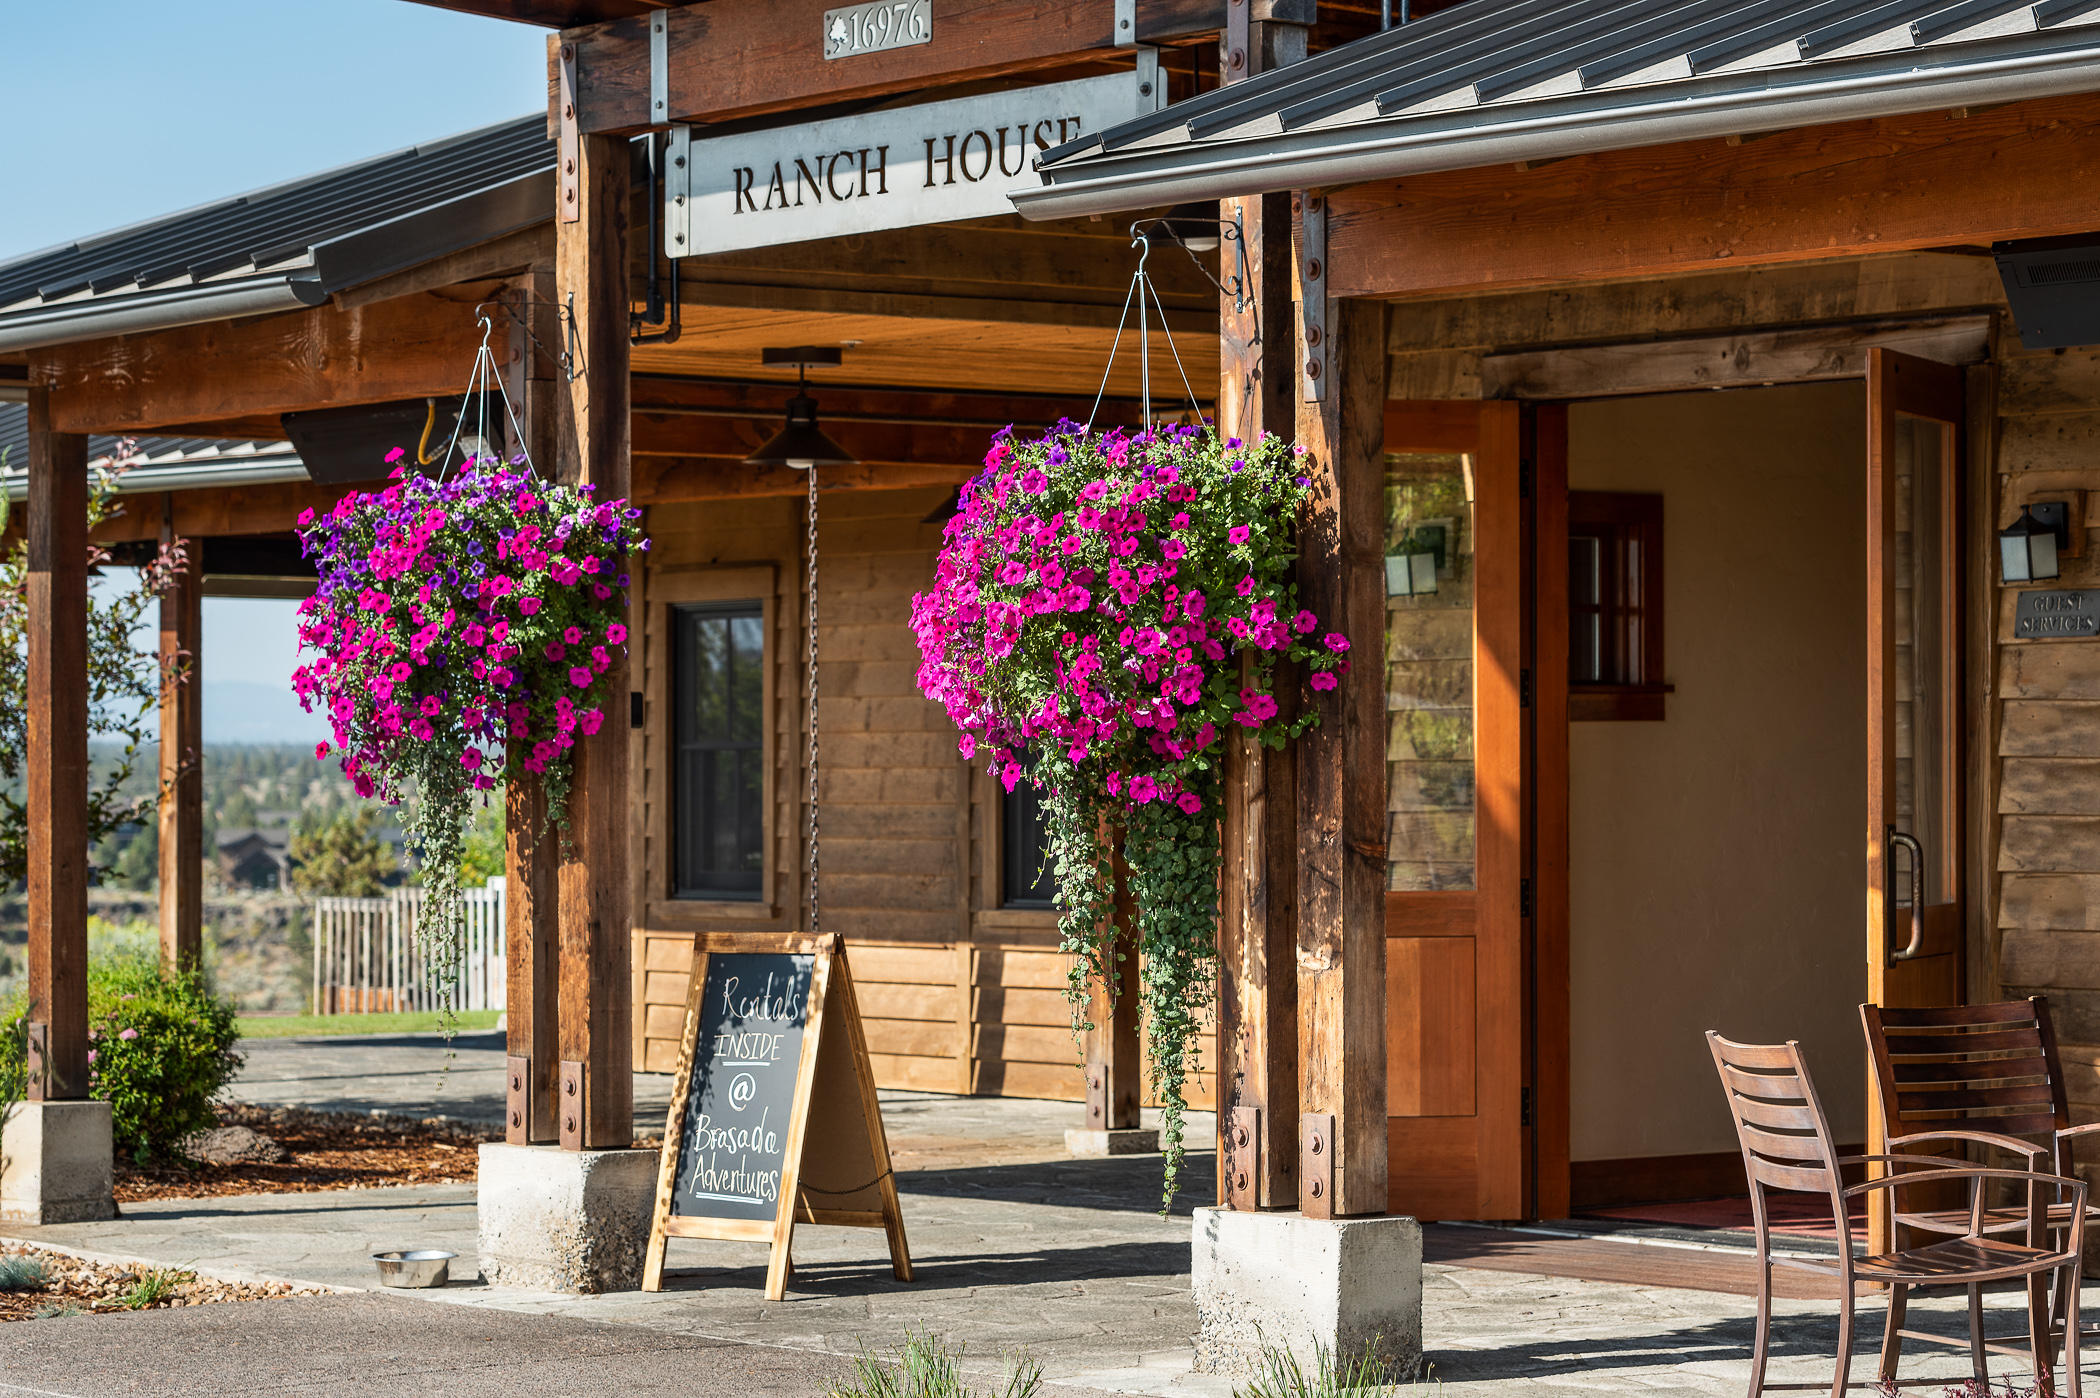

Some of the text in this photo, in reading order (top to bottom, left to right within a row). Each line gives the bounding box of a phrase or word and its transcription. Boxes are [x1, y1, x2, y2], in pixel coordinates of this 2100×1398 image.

[850, 0, 924, 50] 16976
[732, 145, 889, 215] RANCH
[2021, 616, 2093, 632] SERVICES
[2033, 595, 2085, 611] GUEST
[722, 972, 800, 1021] Rentals
[714, 1032, 785, 1061] INSIDE
[728, 1072, 756, 1111] @
[694, 1106, 780, 1154] Brasada
[689, 1152, 779, 1202] Adventures
